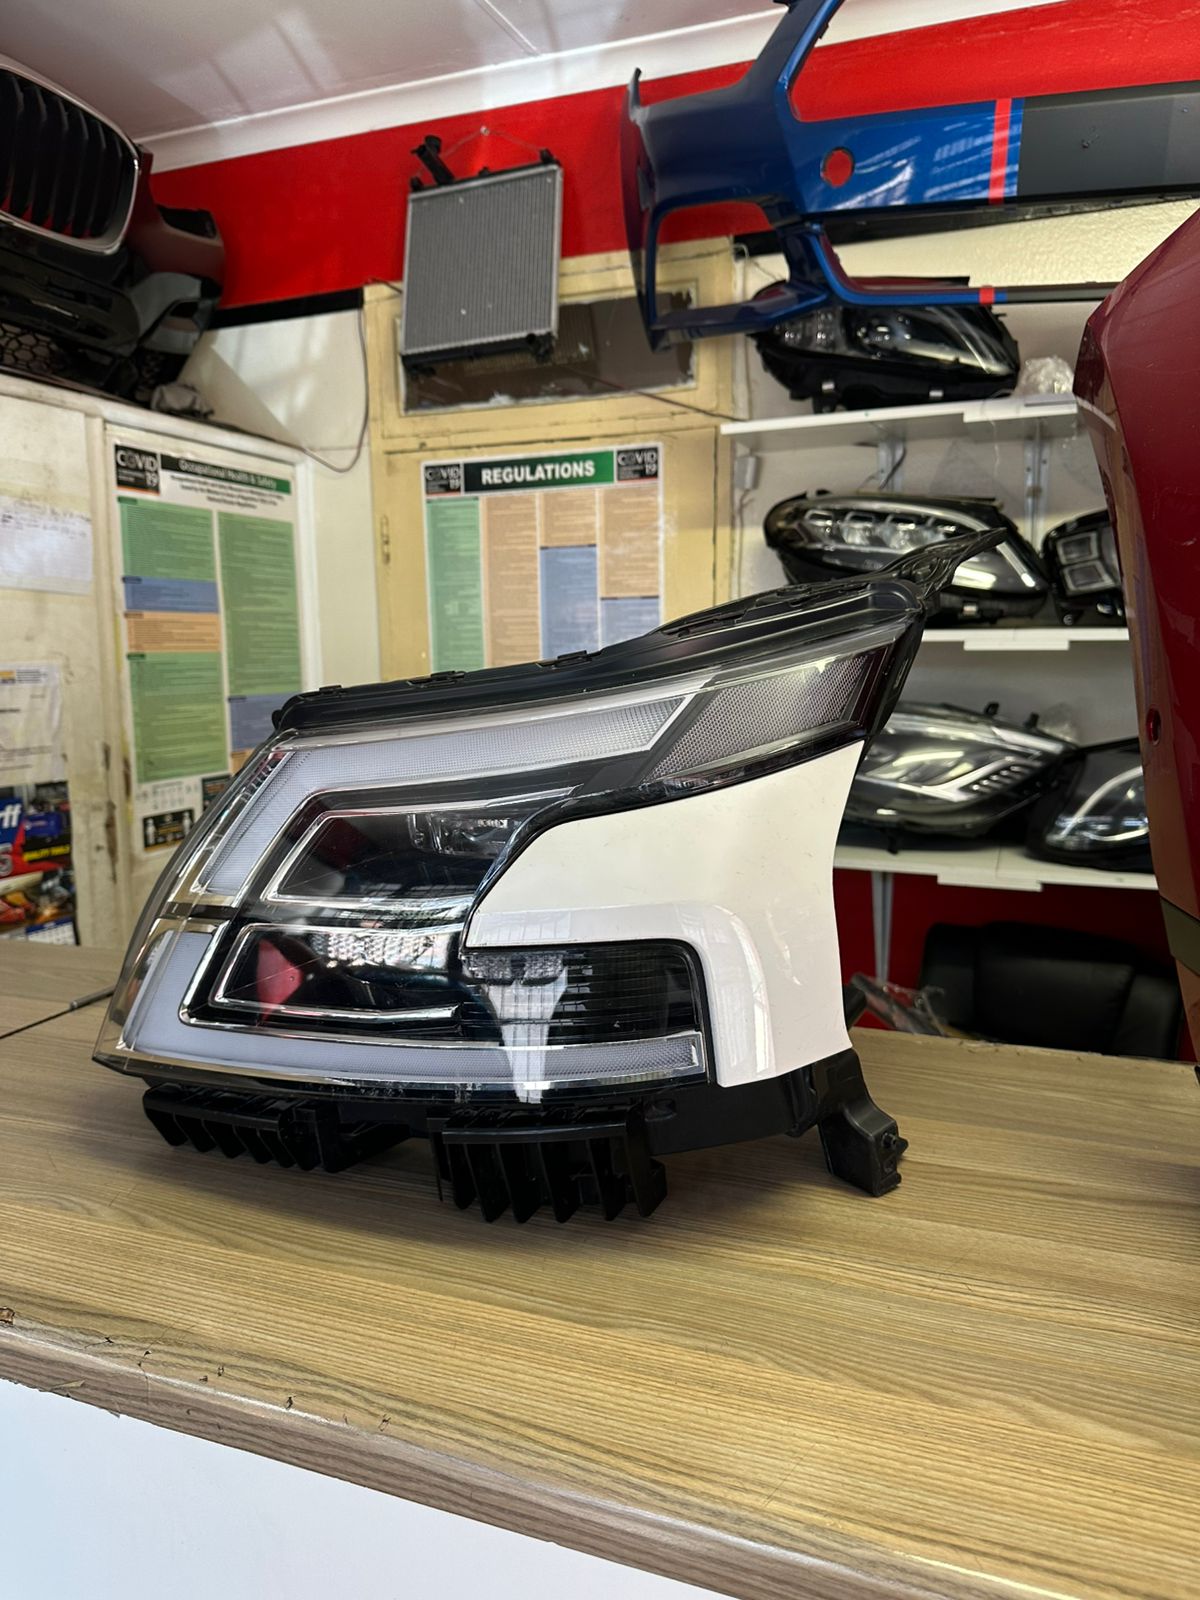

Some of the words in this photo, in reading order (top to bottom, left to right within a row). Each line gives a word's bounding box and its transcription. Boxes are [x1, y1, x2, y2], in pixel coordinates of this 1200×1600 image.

[116, 449, 159, 472] COVID
[616, 449, 657, 466] COVID
[145, 471, 158, 487] 19
[425, 465, 461, 481] COVID
[481, 459, 596, 486] REGULATIONS
